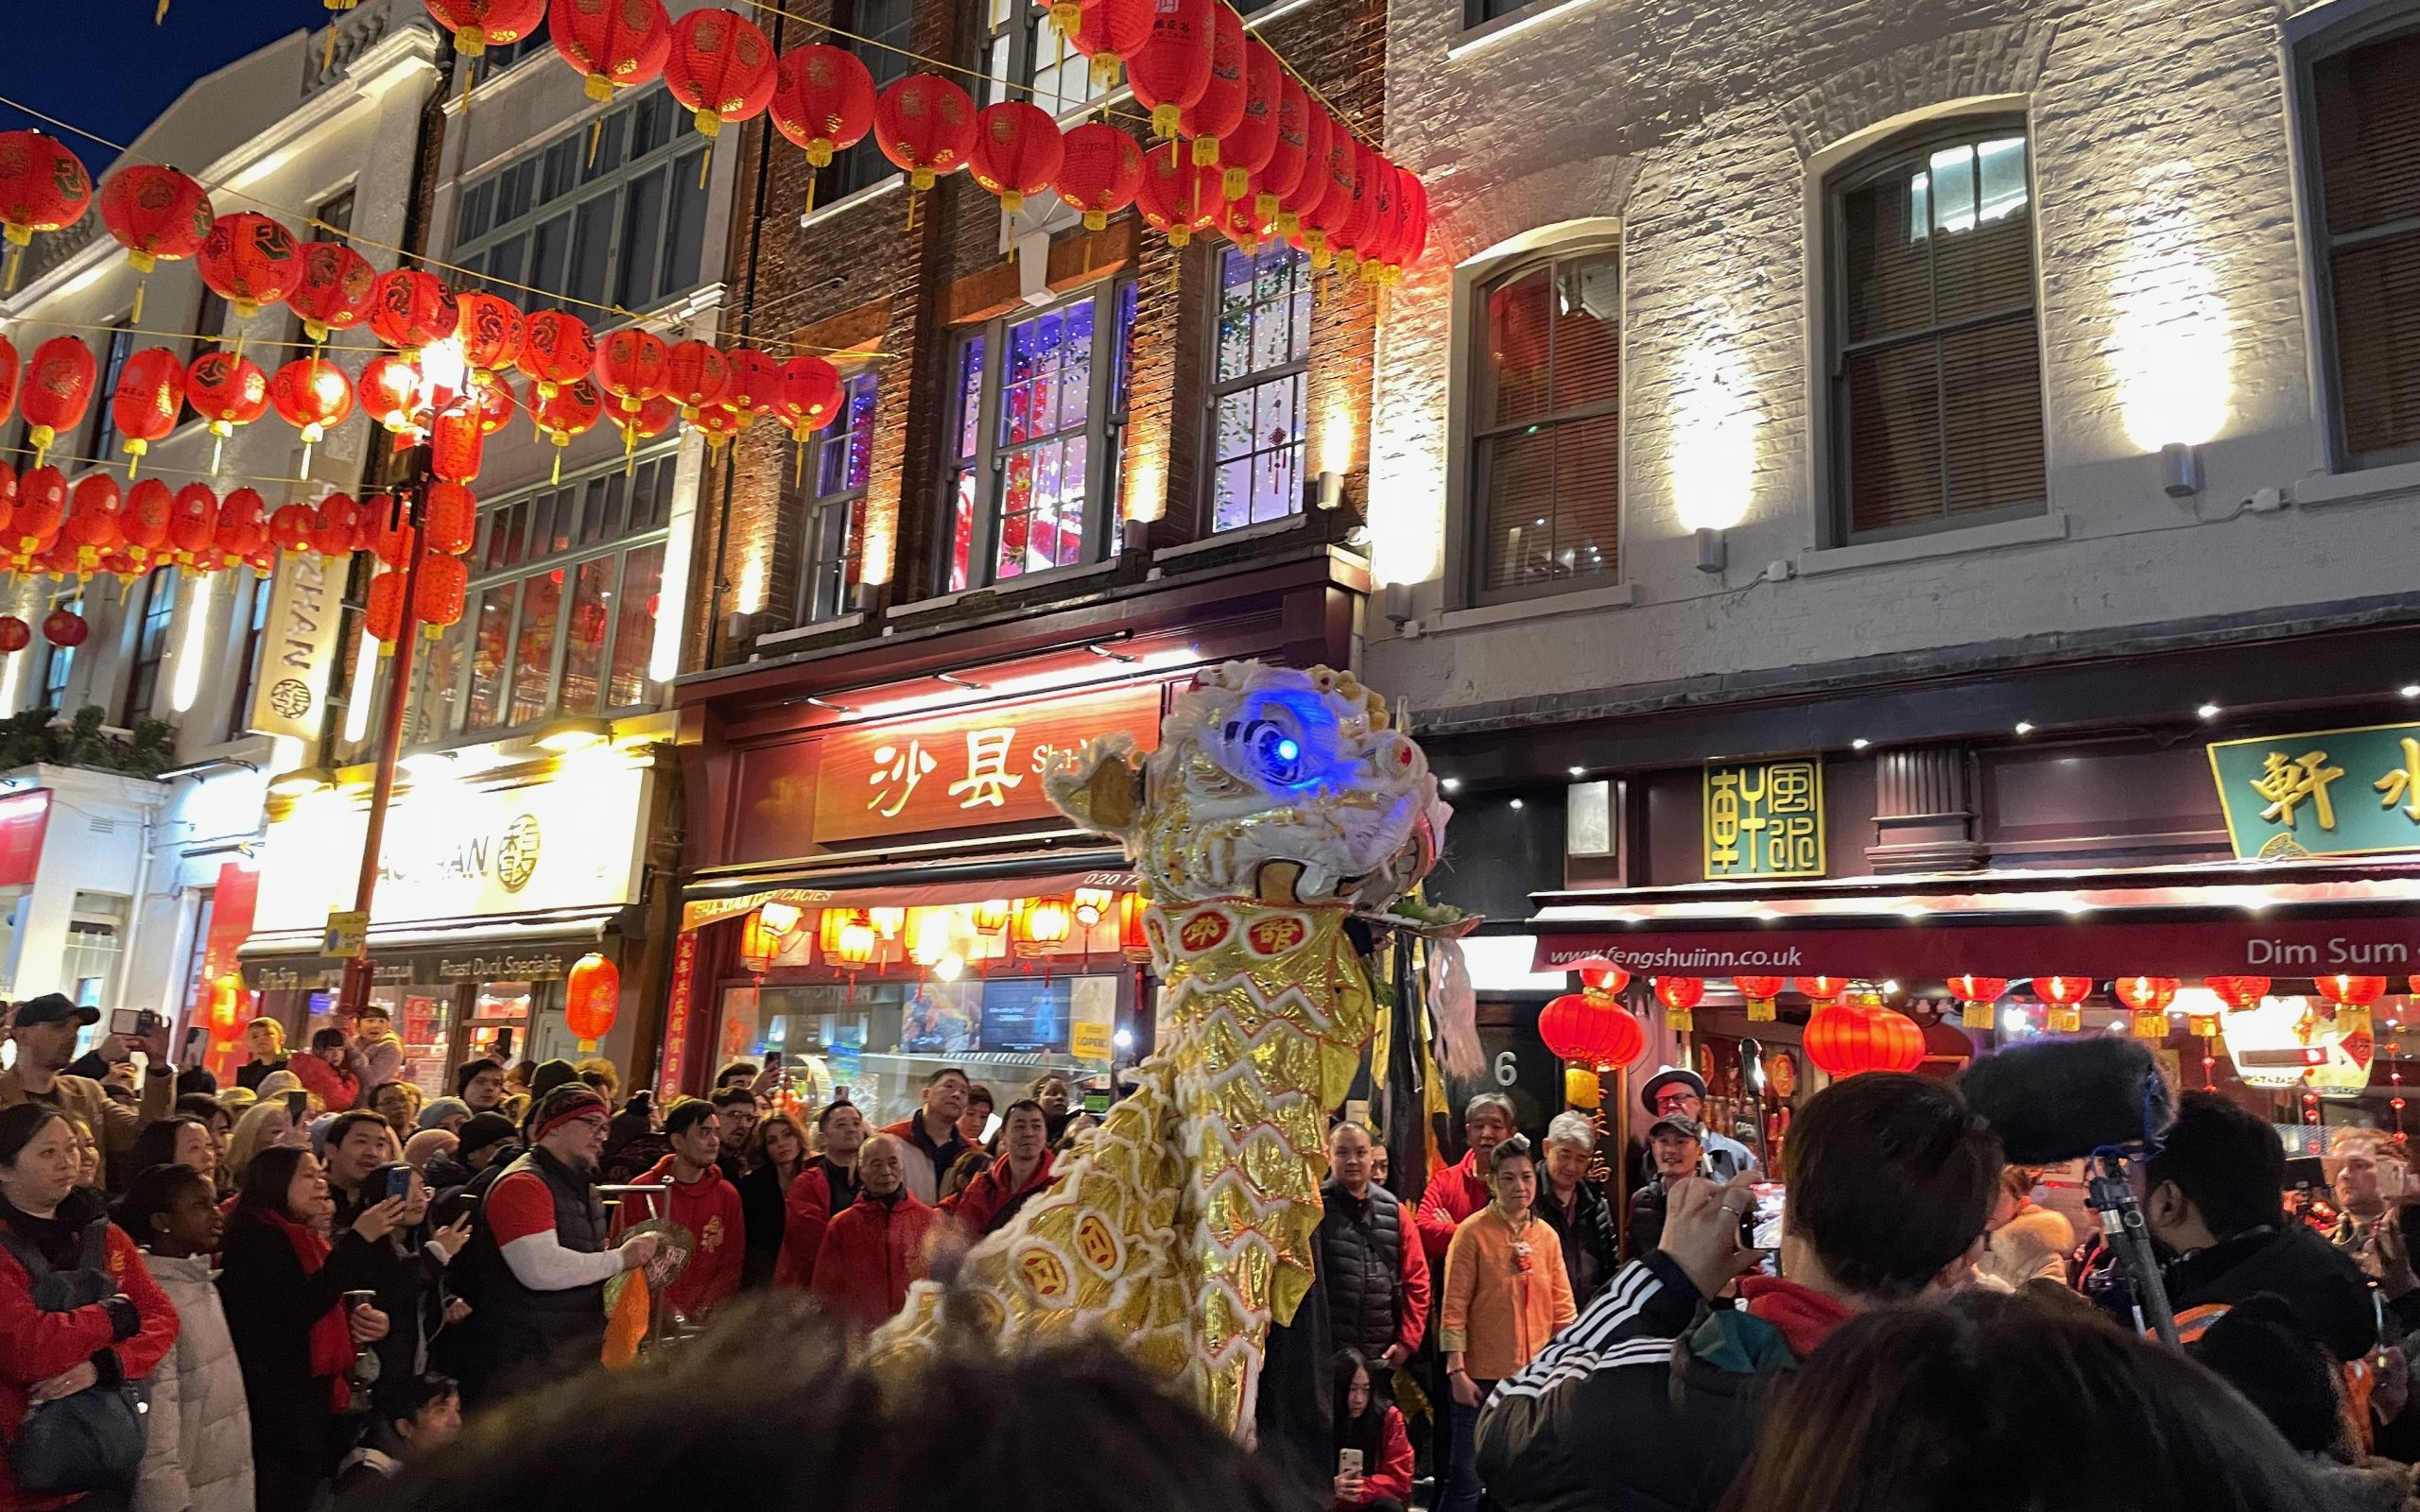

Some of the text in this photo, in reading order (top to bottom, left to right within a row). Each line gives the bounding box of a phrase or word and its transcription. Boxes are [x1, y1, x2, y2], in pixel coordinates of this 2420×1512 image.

[868, 728, 1023, 817] 沙县
[1083, 873, 1121, 885] 020
[1550, 946, 1802, 970] www.fengshuiinn.co.uk
[2246, 937, 2408, 965] Dim Sum
[474, 955, 502, 975] Duck
[503, 954, 562, 974] Specialist
[1495, 1051, 1518, 1087] 6
